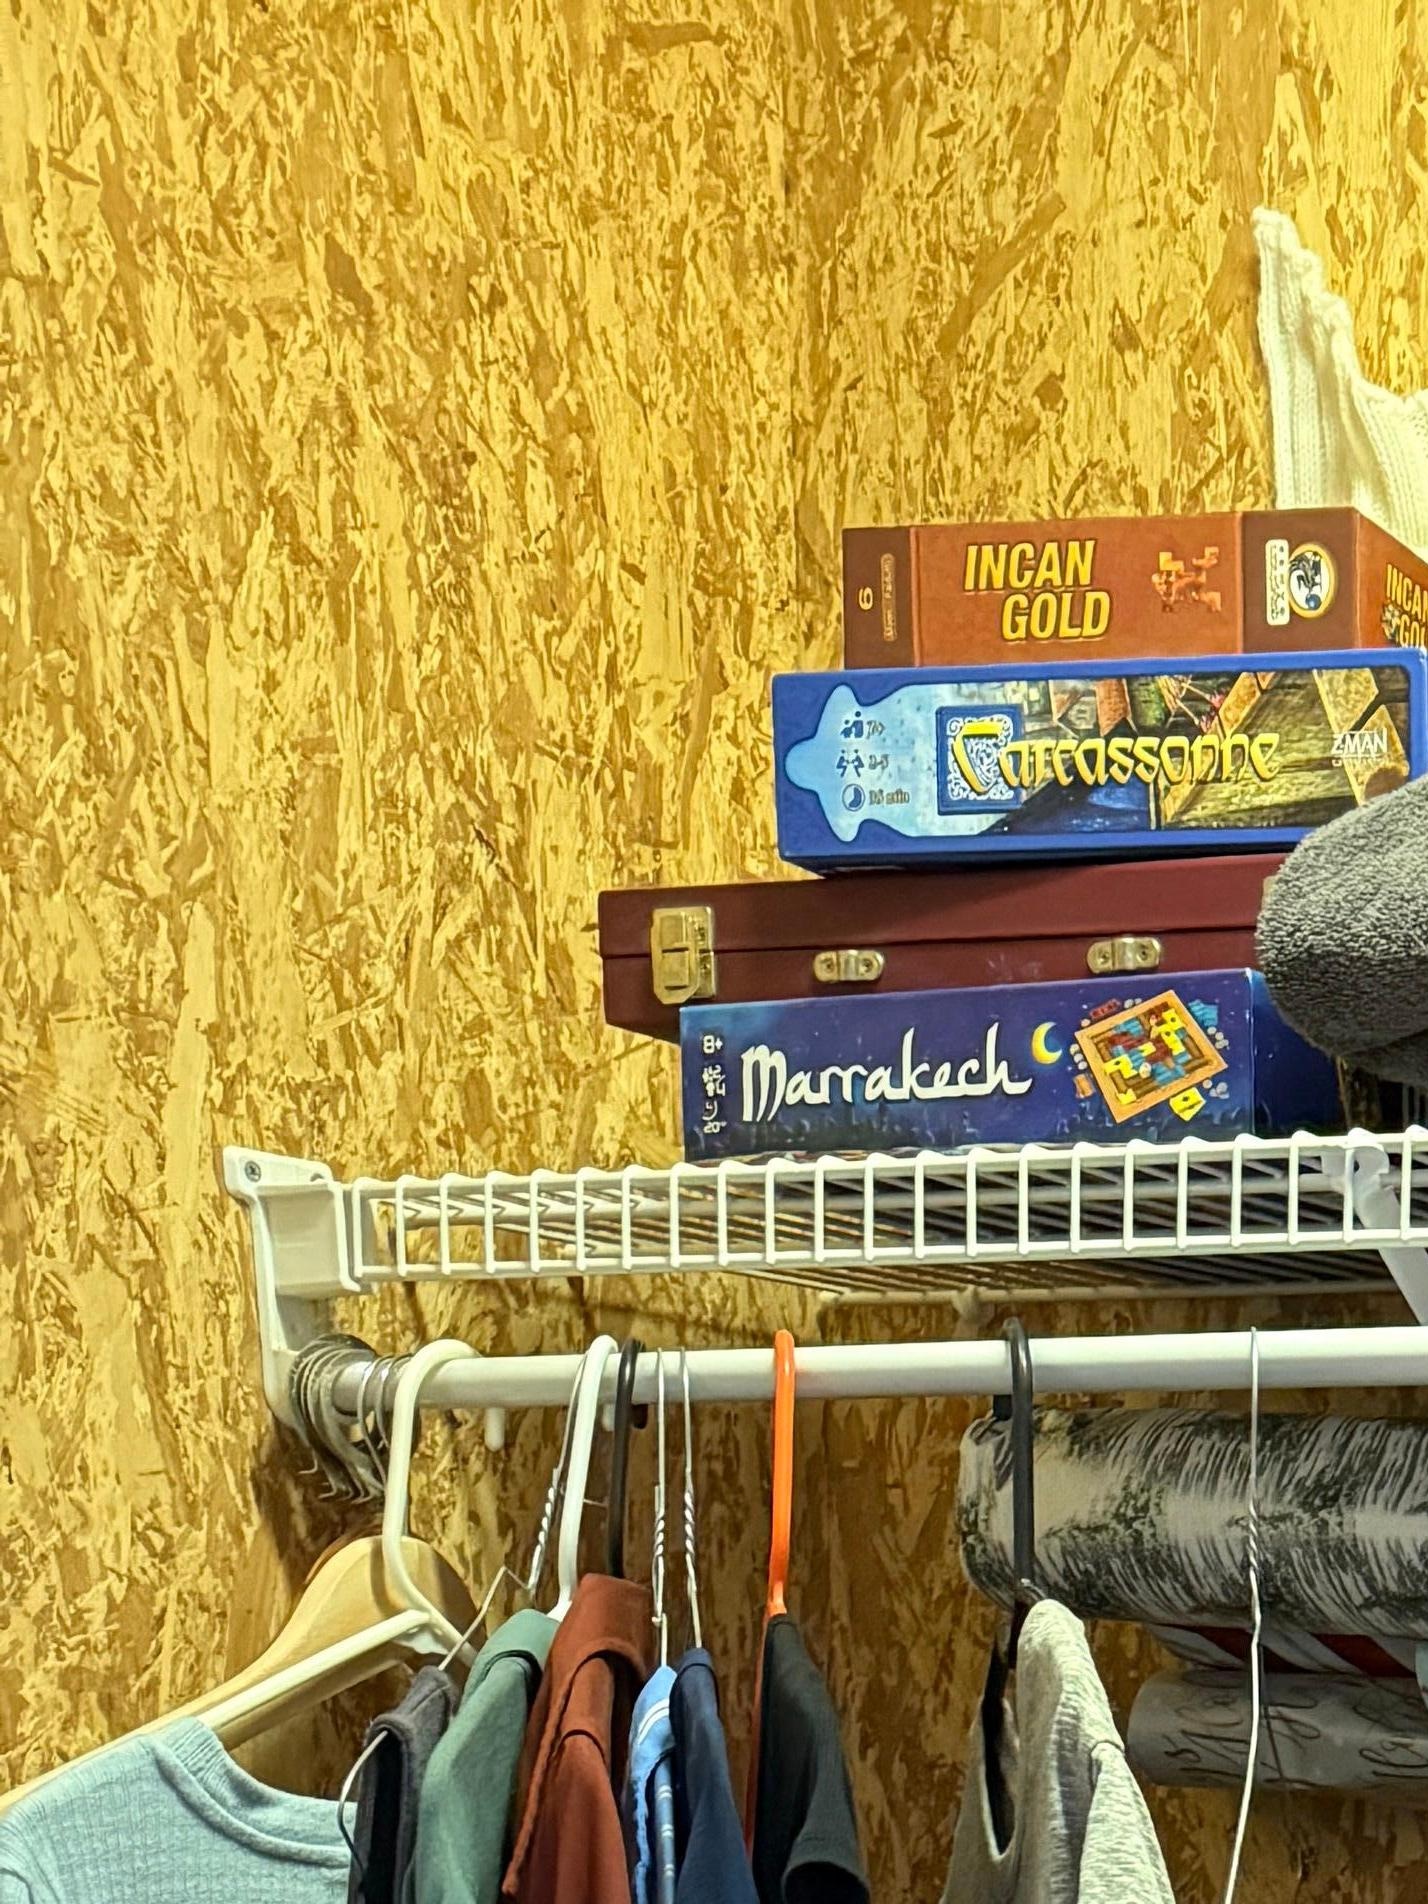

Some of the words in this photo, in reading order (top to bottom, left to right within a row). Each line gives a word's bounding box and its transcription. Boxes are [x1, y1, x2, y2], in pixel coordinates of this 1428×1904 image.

[963, 540, 1095, 592] INCAN
[1001, 591, 1111, 642] GOLD
[952, 720, 1280, 797] Carcassonne
[741, 1021, 1034, 1123] Marrakech
